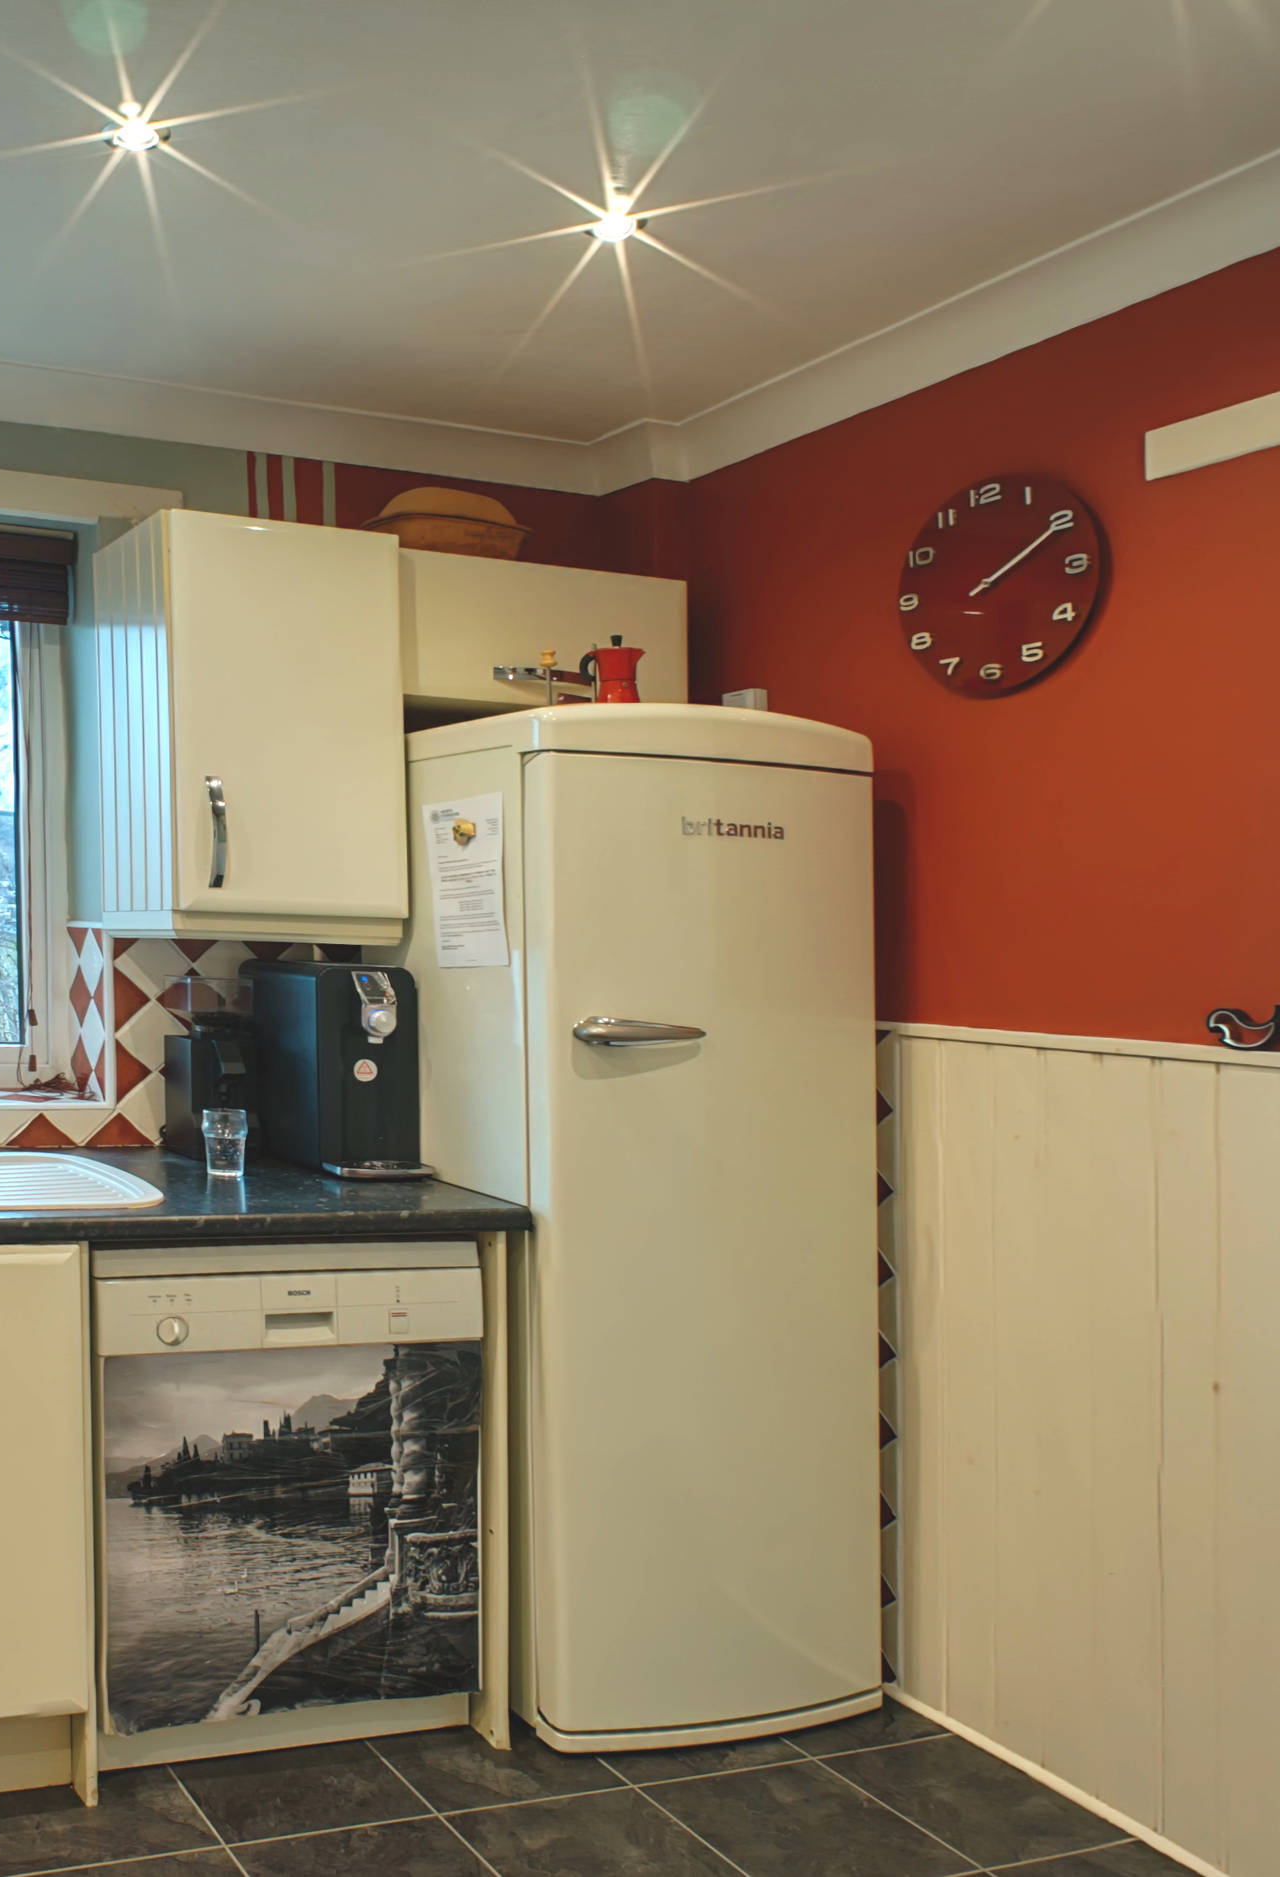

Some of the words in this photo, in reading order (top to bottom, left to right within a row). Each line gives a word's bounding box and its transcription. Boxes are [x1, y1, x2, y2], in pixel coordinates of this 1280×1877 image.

[970, 483, 1001, 507] 12
[1025, 486, 1032, 505] 1
[938, 509, 955, 528] 11
[1049, 510, 1074, 531] 2
[909, 547, 934, 567] 10
[1065, 553, 1088, 574] 3
[899, 594, 918, 611] 9
[1052, 603, 1075, 621] 4
[911, 632, 931, 650] 8
[1021, 642, 1043, 662] 5
[939, 657, 960, 675] 7
[979, 664, 1002, 679] 6
[681, 816, 785, 840] britannia
